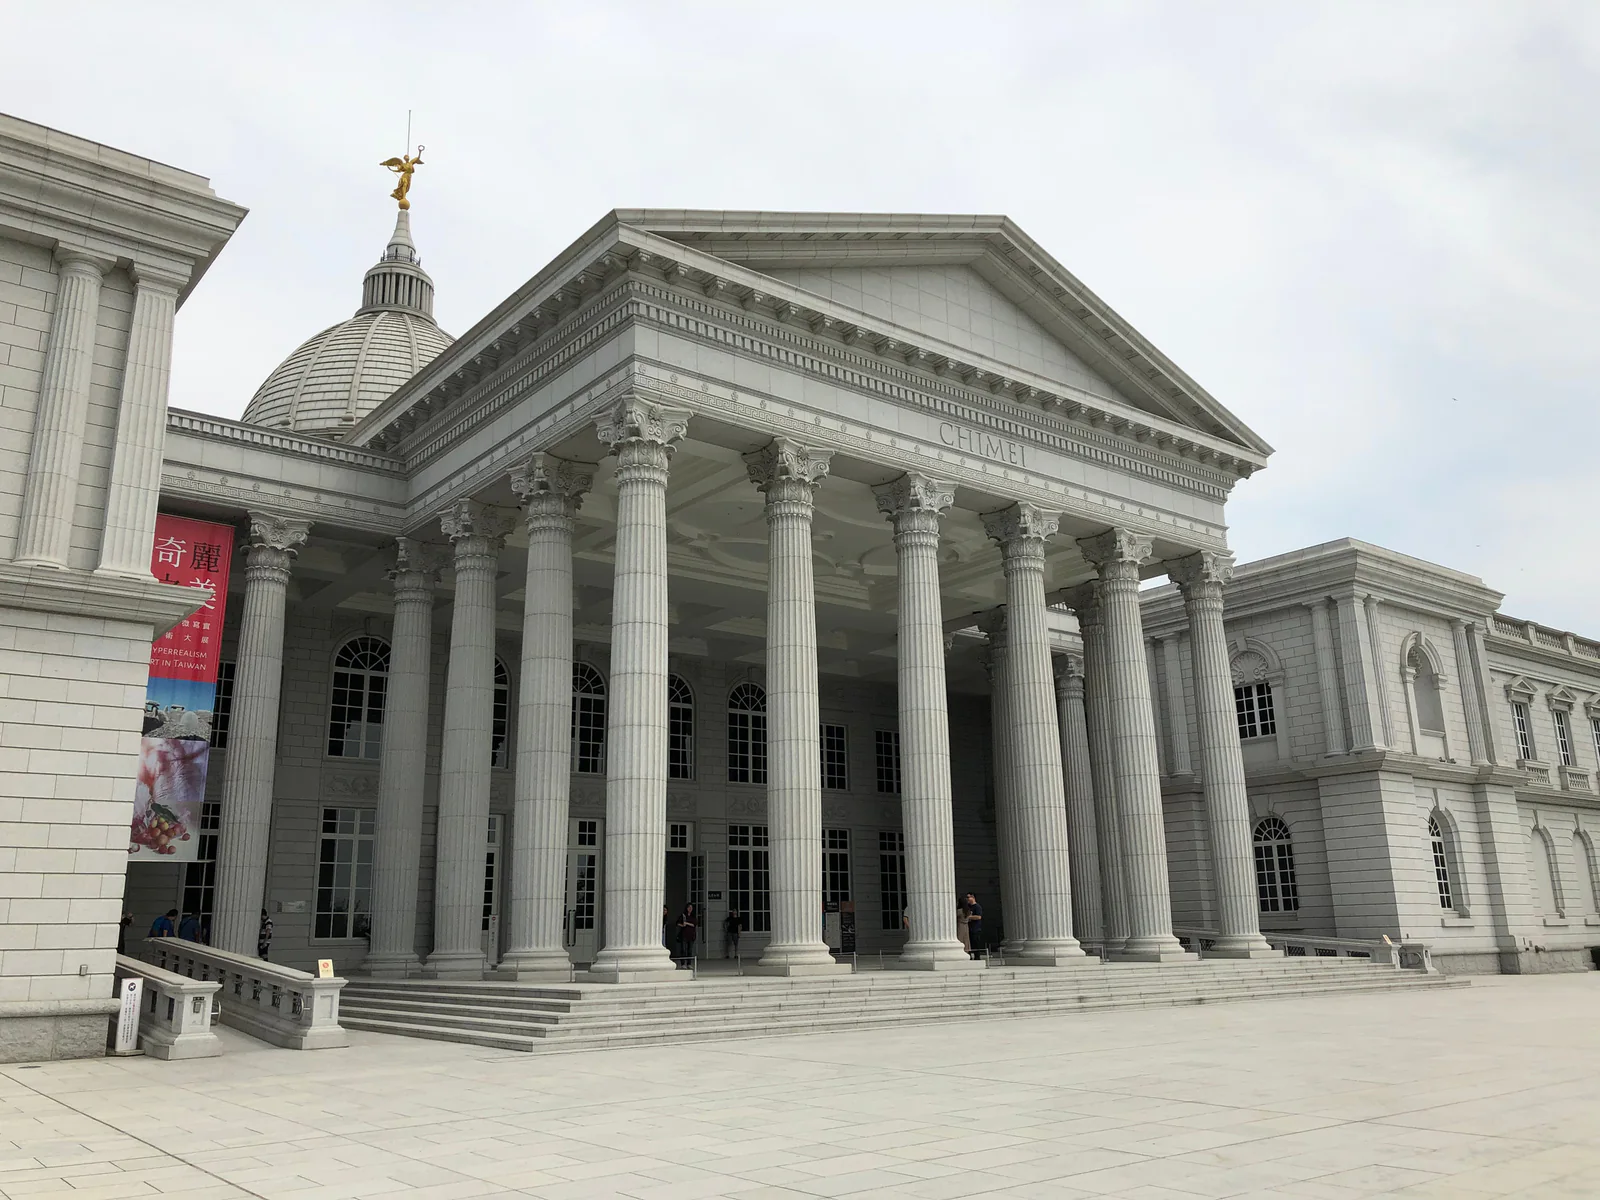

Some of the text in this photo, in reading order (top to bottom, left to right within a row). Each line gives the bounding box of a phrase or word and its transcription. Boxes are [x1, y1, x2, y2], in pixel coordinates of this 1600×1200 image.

[940, 422, 1026, 467] CHIMEI
[155, 536, 221, 573] 奇麗
[150, 658, 160, 666] RT
[174, 660, 207, 671] TAIWAN
[152, 646, 207, 659] YPERREALISM
